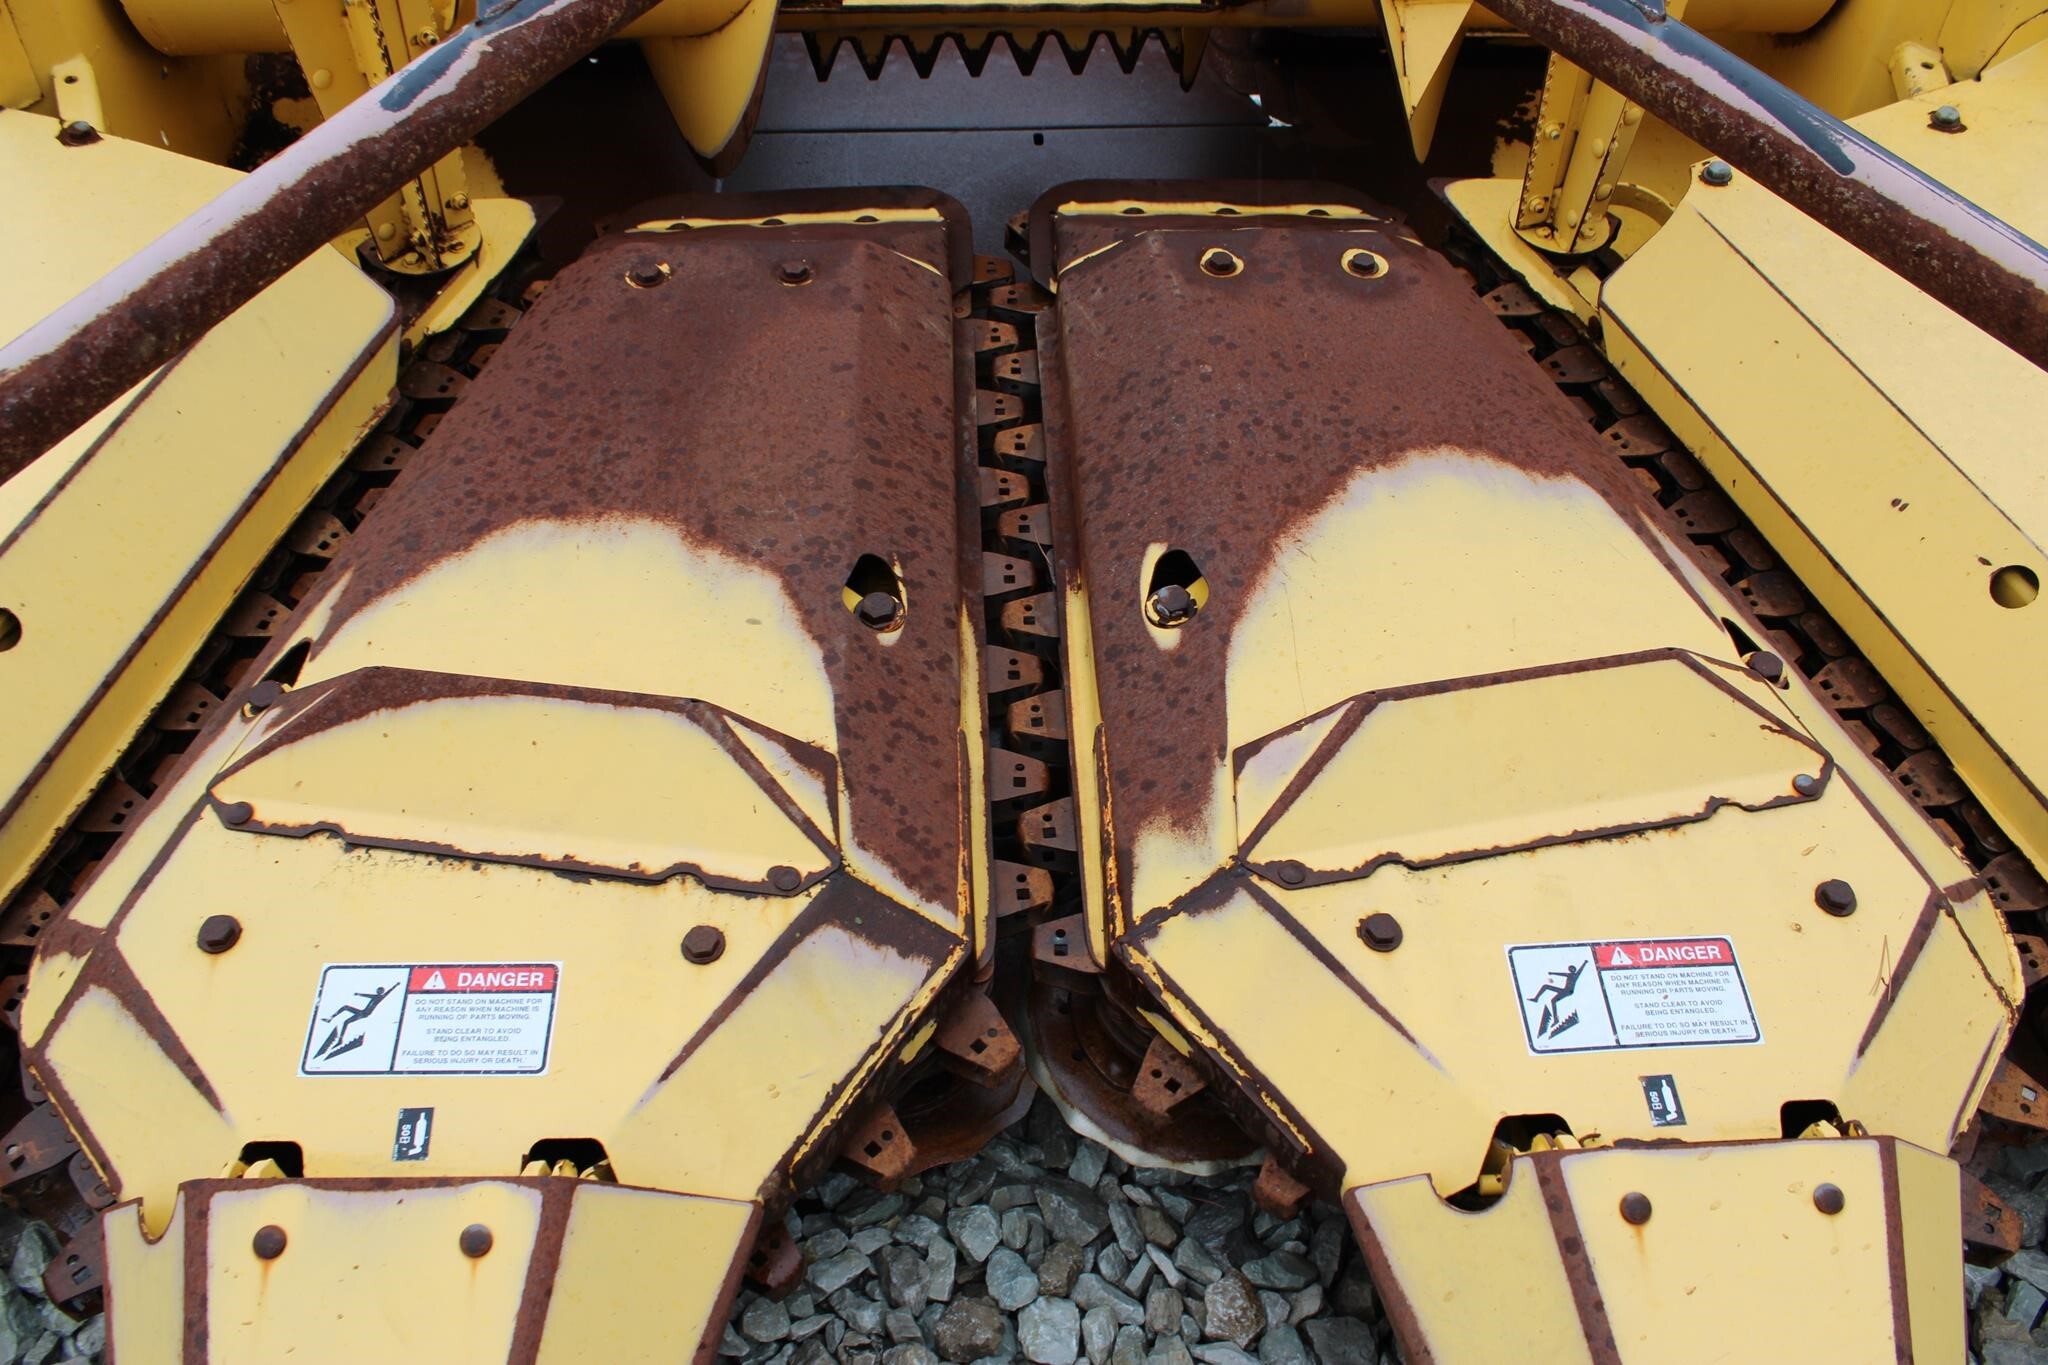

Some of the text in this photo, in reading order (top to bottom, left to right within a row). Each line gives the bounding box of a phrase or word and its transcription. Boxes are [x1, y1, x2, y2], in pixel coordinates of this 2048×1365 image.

[1639, 945, 1722, 962] DANGER
[457, 972, 544, 987] DANGER
[1641, 973, 1666, 981] STAND
[1632, 980, 1663, 988] REASON
[1620, 988, 1655, 996] RUNNING
[1661, 1000, 1687, 1008] CLEAR
[418, 1013, 454, 1021] RUNNING
[470, 1013, 497, 1021] PARTS
[1620, 1023, 1653, 1031] FAILURE
[1709, 1019, 1739, 1027] RESULT
[433, 1035, 458, 1043] BEING
[413, 1057, 449, 1065] SERIOUS
[450, 1057, 479, 1065] INJURY
[481, 1057, 493, 1065] OR
